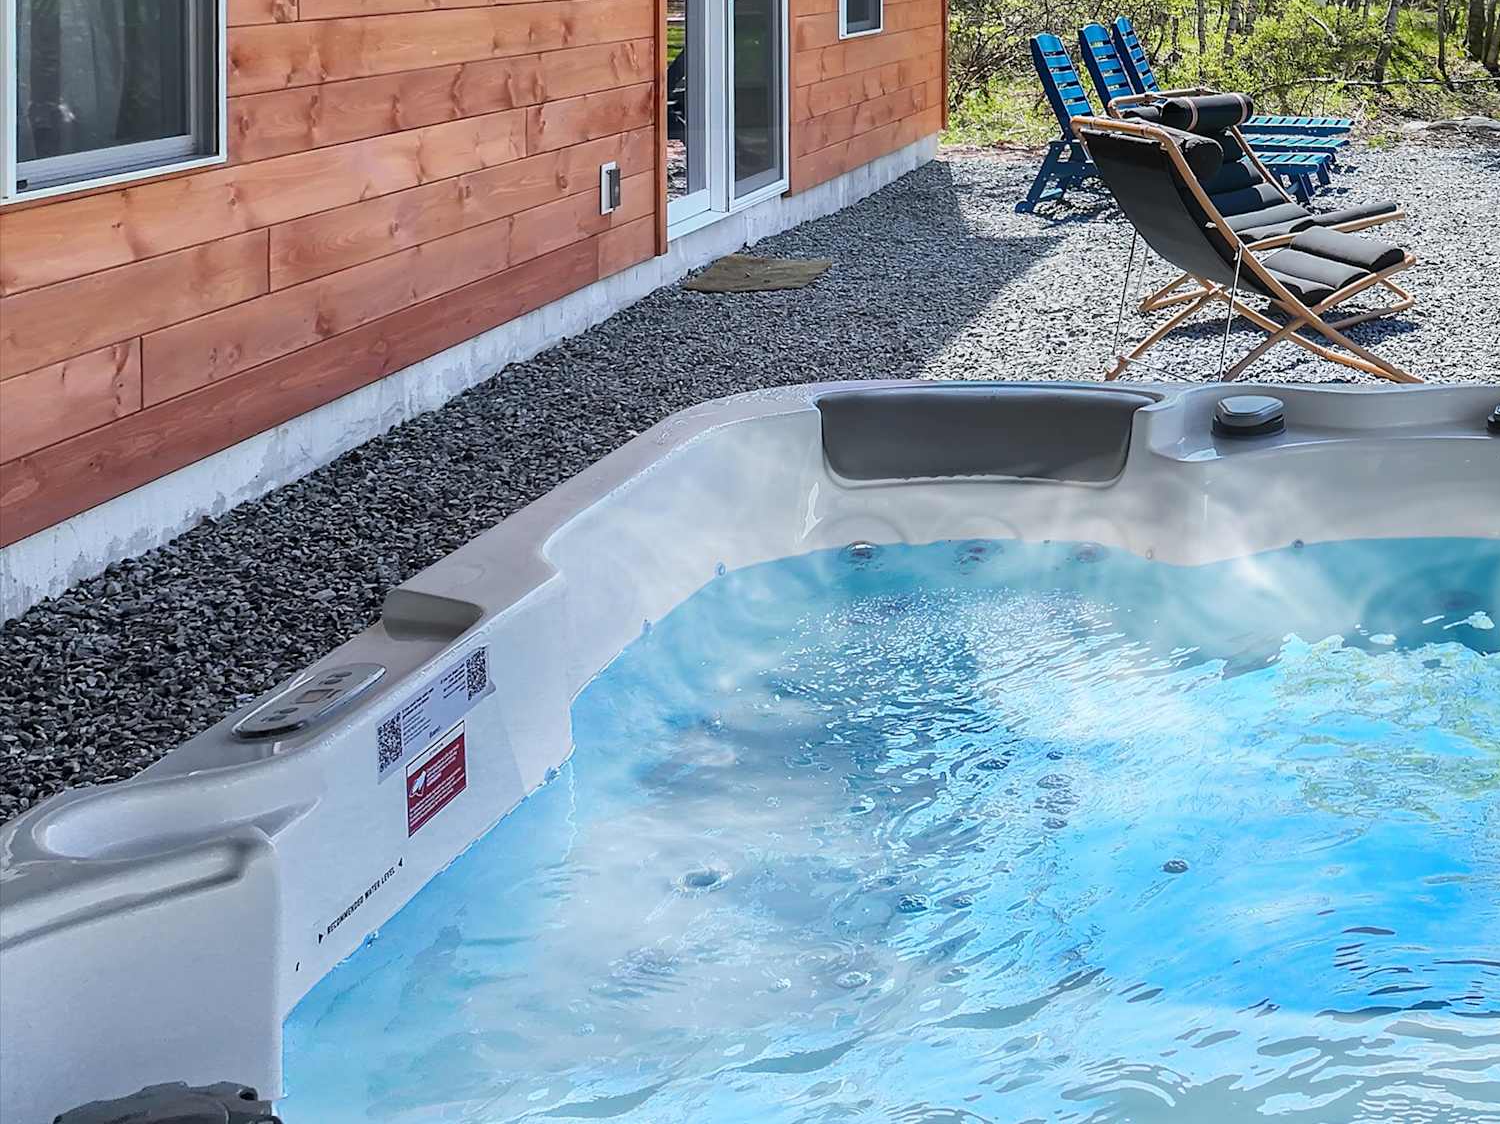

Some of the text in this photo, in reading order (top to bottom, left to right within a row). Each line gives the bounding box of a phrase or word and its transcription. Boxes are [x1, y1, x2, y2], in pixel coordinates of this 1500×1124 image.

[327, 866, 396, 934] RECOMMENDED WATER LEVEL
